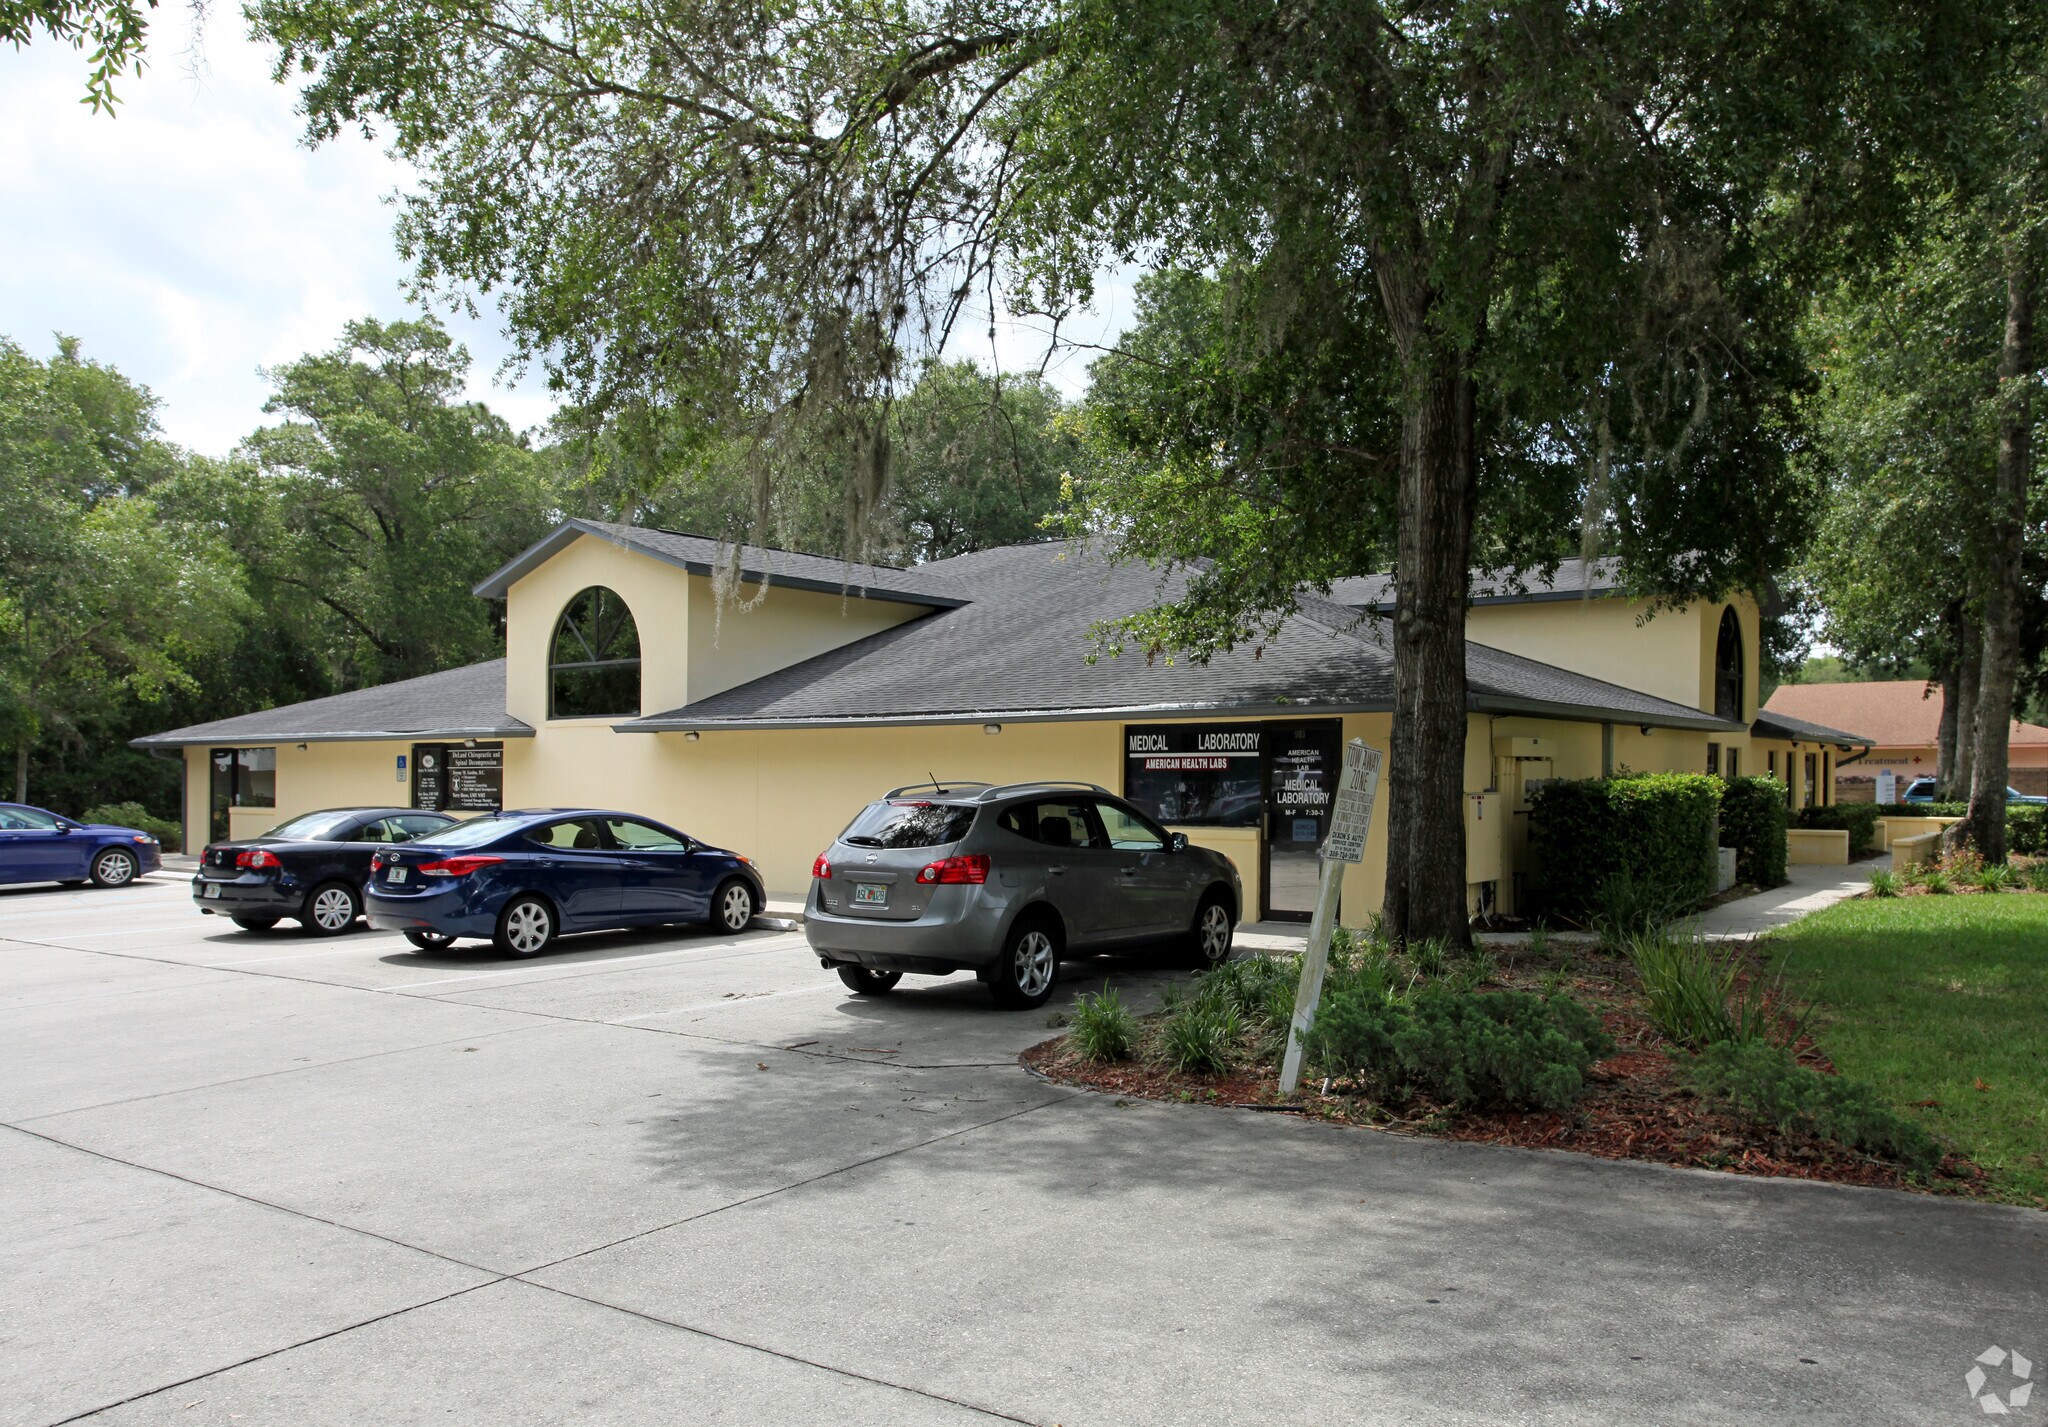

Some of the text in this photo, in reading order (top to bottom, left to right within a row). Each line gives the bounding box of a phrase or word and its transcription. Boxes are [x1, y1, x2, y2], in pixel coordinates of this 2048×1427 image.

[1129, 733, 1260, 751] MEDICAL LABORATORY
[455, 759, 497, 767] Spinal Decompression
[1145, 758, 1228, 770] AMERICAN HEALTH LABS
[1346, 745, 1381, 774] TOW AWAY
[1858, 757, 1909, 765] Treatment
[1284, 779, 1320, 791] MEDICAL
[1350, 769, 1370, 792] ZONE
[1277, 792, 1330, 804] LABORATORY
[1332, 838, 1347, 846] SERVICE
[1351, 834, 1364, 842] AUTO
